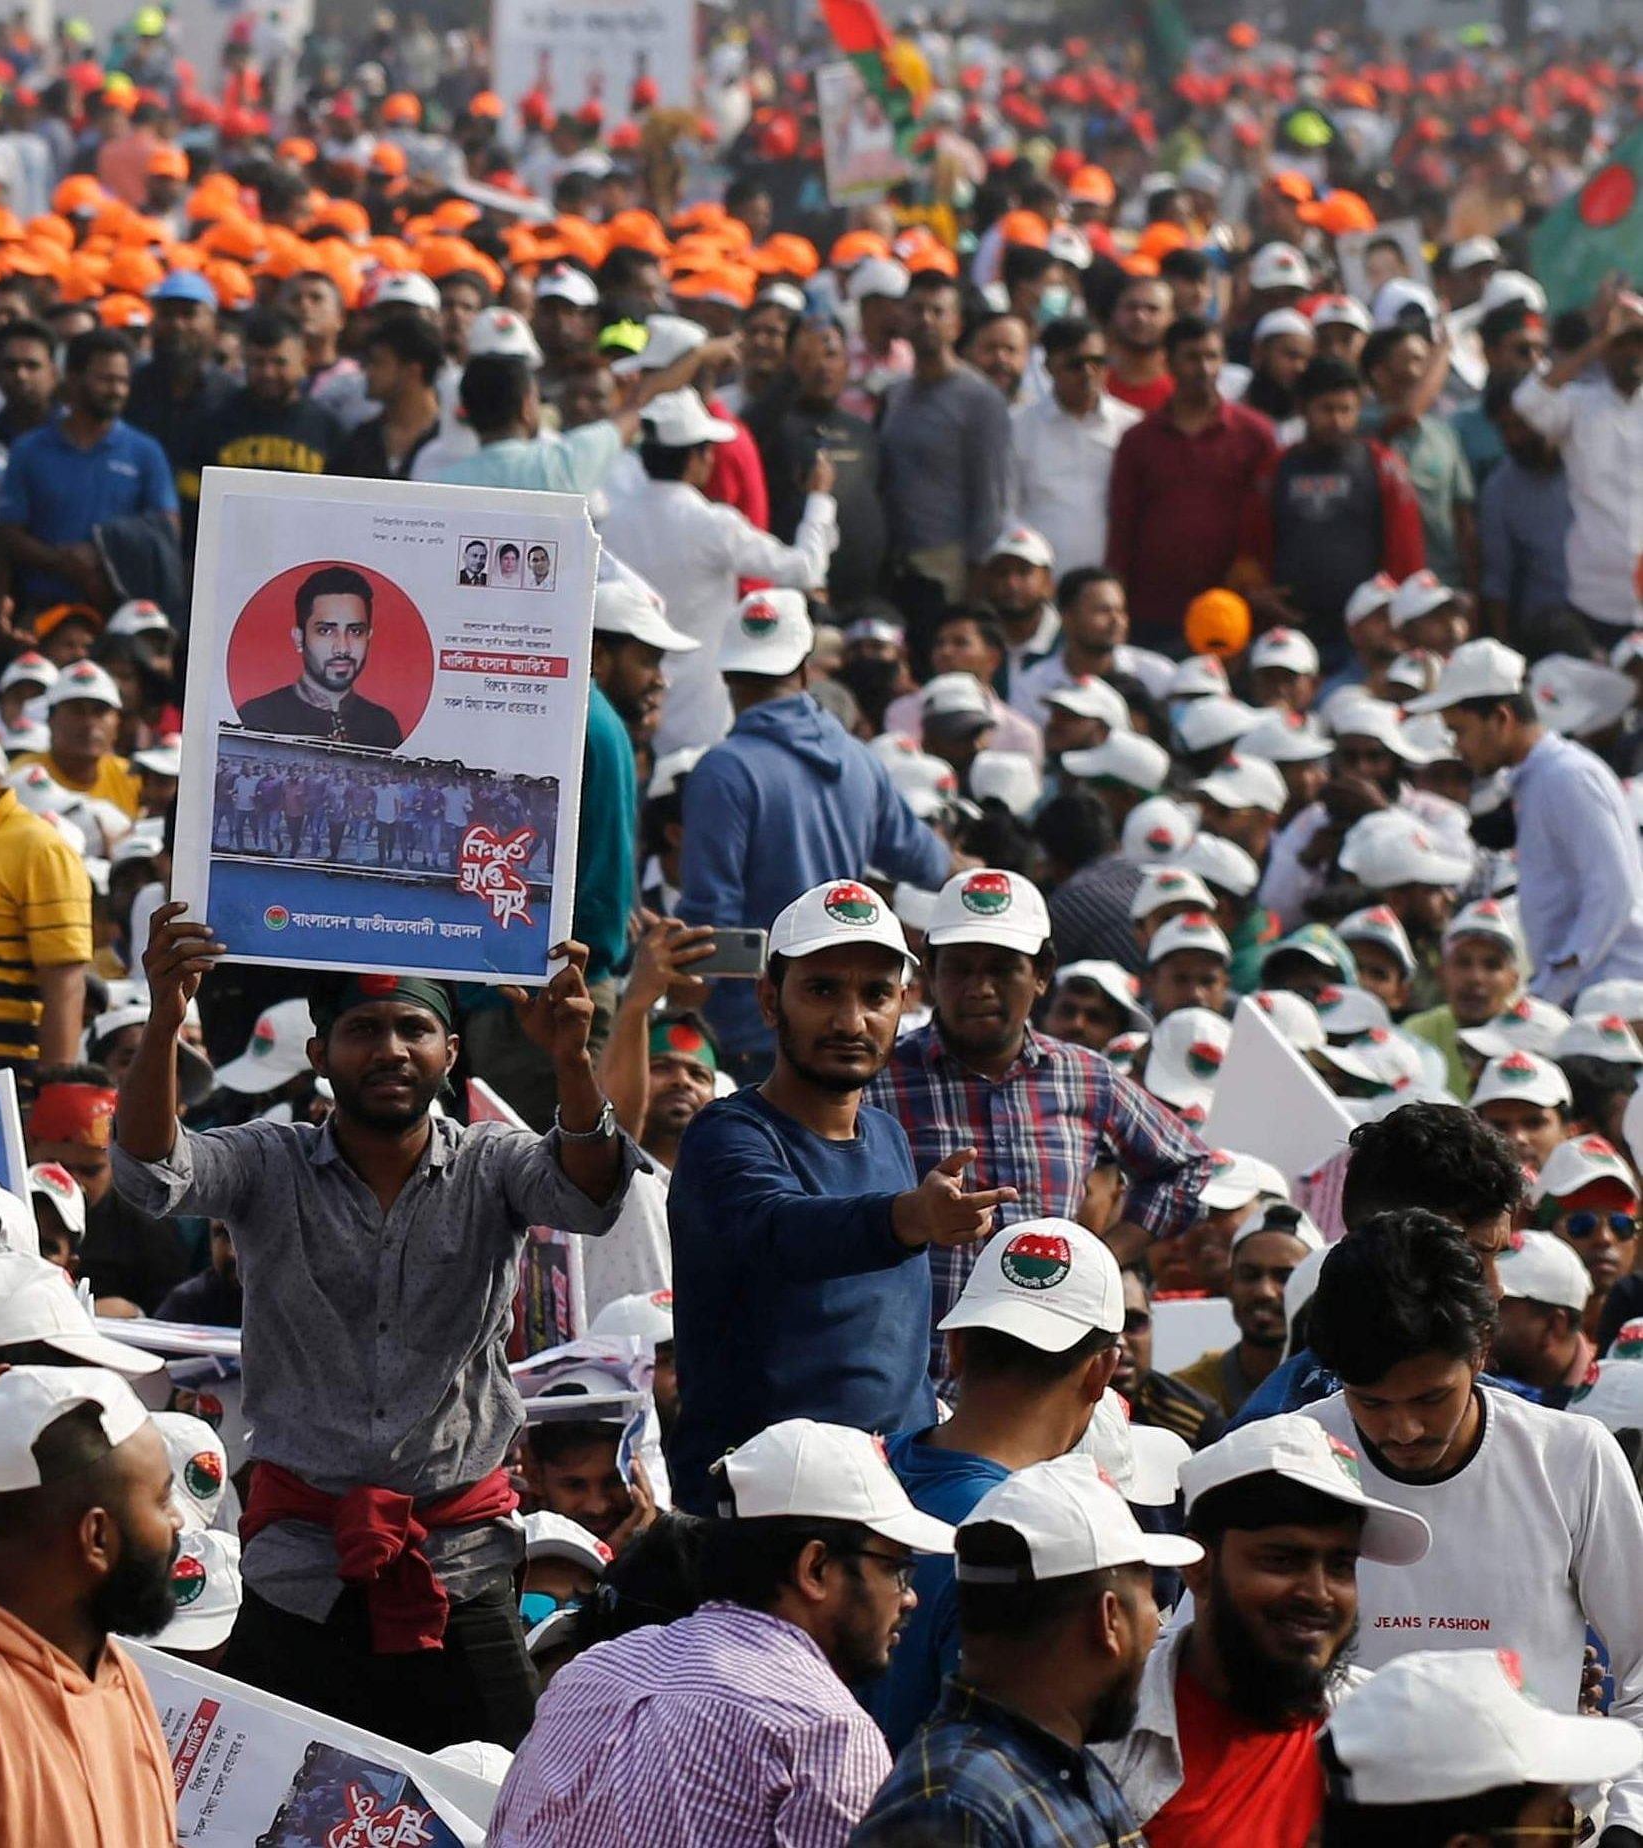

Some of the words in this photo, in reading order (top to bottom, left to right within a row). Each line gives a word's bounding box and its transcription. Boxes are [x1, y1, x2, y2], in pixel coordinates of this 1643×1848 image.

[485, 874, 534, 929] চাই
[292, 912, 350, 931] বাংলাদেশ
[354, 913, 435, 937] জাতীয়তাবাদী
[439, 922, 483, 940] ছাত্রদল
[1373, 1616, 1422, 1628] JEANS
[1428, 1617, 1490, 1631] FASHION
